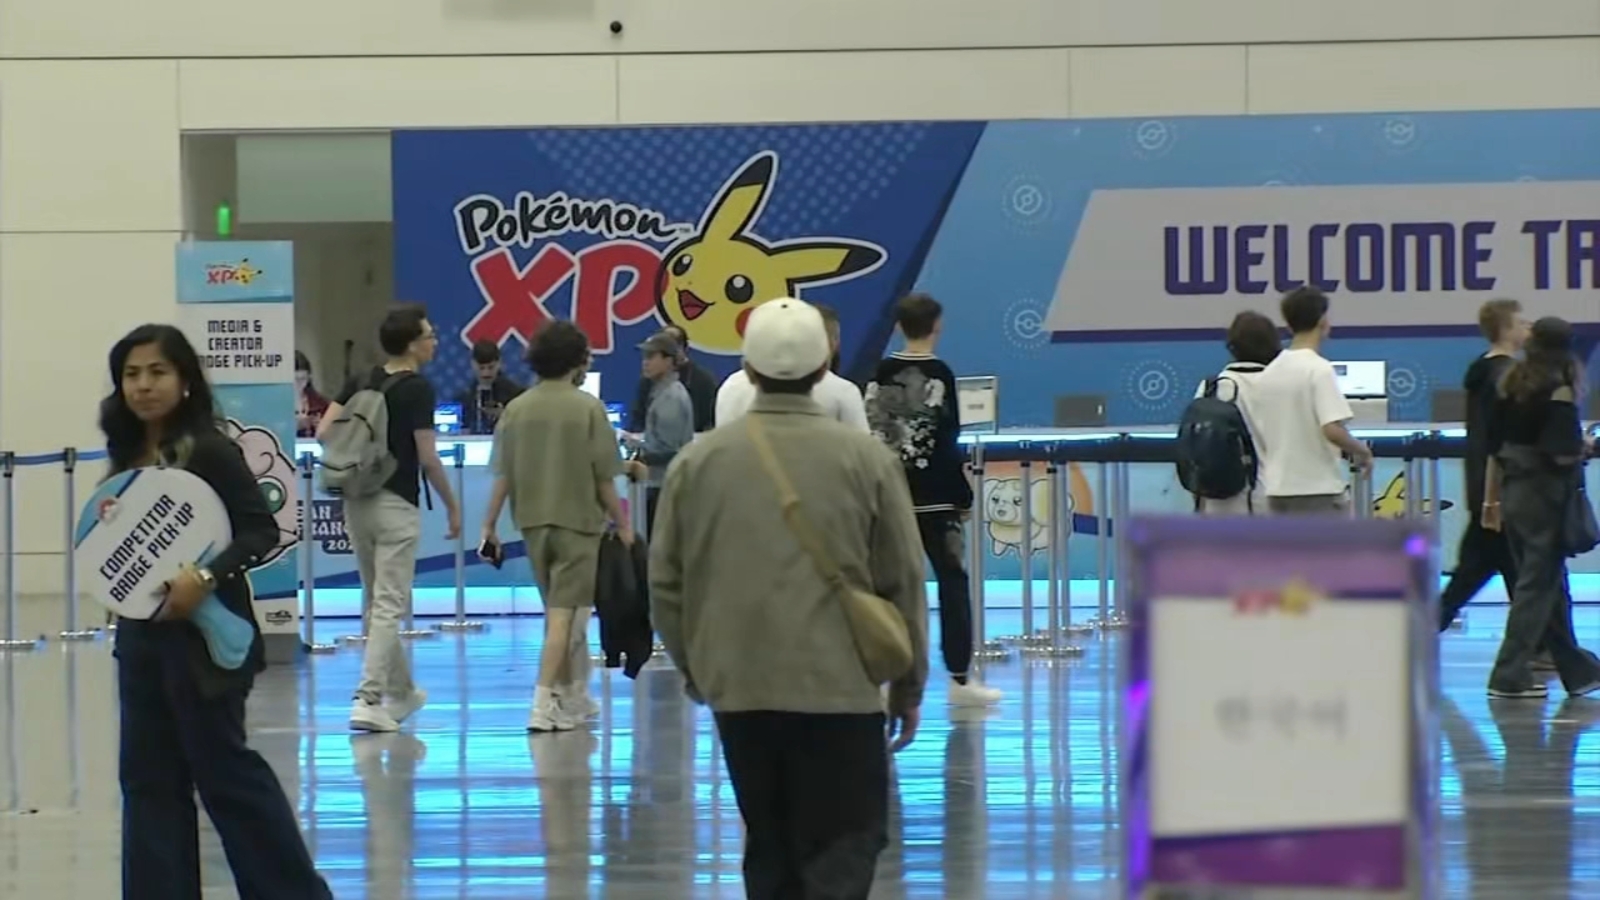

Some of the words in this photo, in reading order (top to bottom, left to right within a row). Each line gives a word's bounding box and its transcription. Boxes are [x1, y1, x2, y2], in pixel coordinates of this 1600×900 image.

[457, 194, 676, 250] Pokémon
[1164, 221, 1496, 294] WELCOME
[207, 319, 249, 333] MEDIA
[253, 319, 263, 333] &
[463, 243, 660, 354] XP
[207, 337, 263, 351] CREATOR
[234, 354, 282, 368] PICK-UP
[99, 494, 176, 581] COMPETITOR
[109, 554, 153, 603] BADGE
[147, 501, 195, 559] PICK-UP
